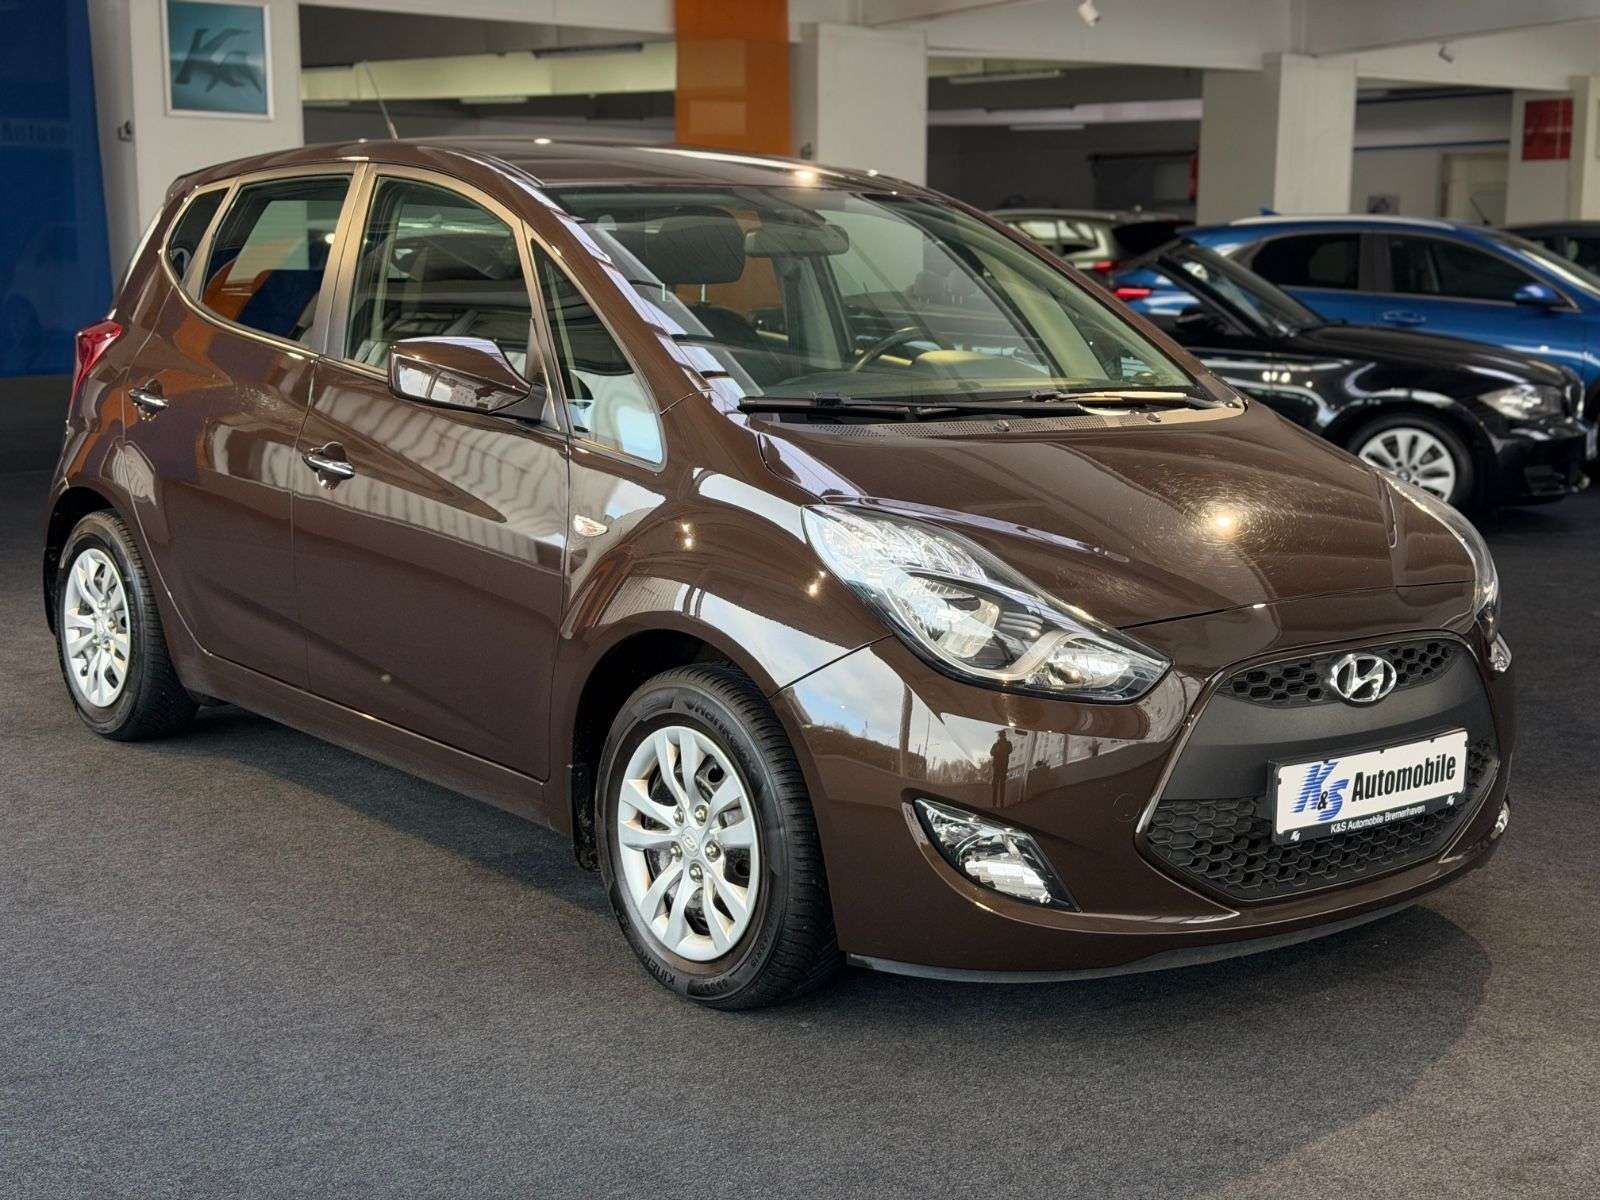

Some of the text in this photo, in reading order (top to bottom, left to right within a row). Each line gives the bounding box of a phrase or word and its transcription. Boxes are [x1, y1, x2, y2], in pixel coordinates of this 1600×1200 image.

[1351, 753, 1457, 802] Automobile
[1330, 805, 1426, 834] K&S Automobile Bremerhaven
